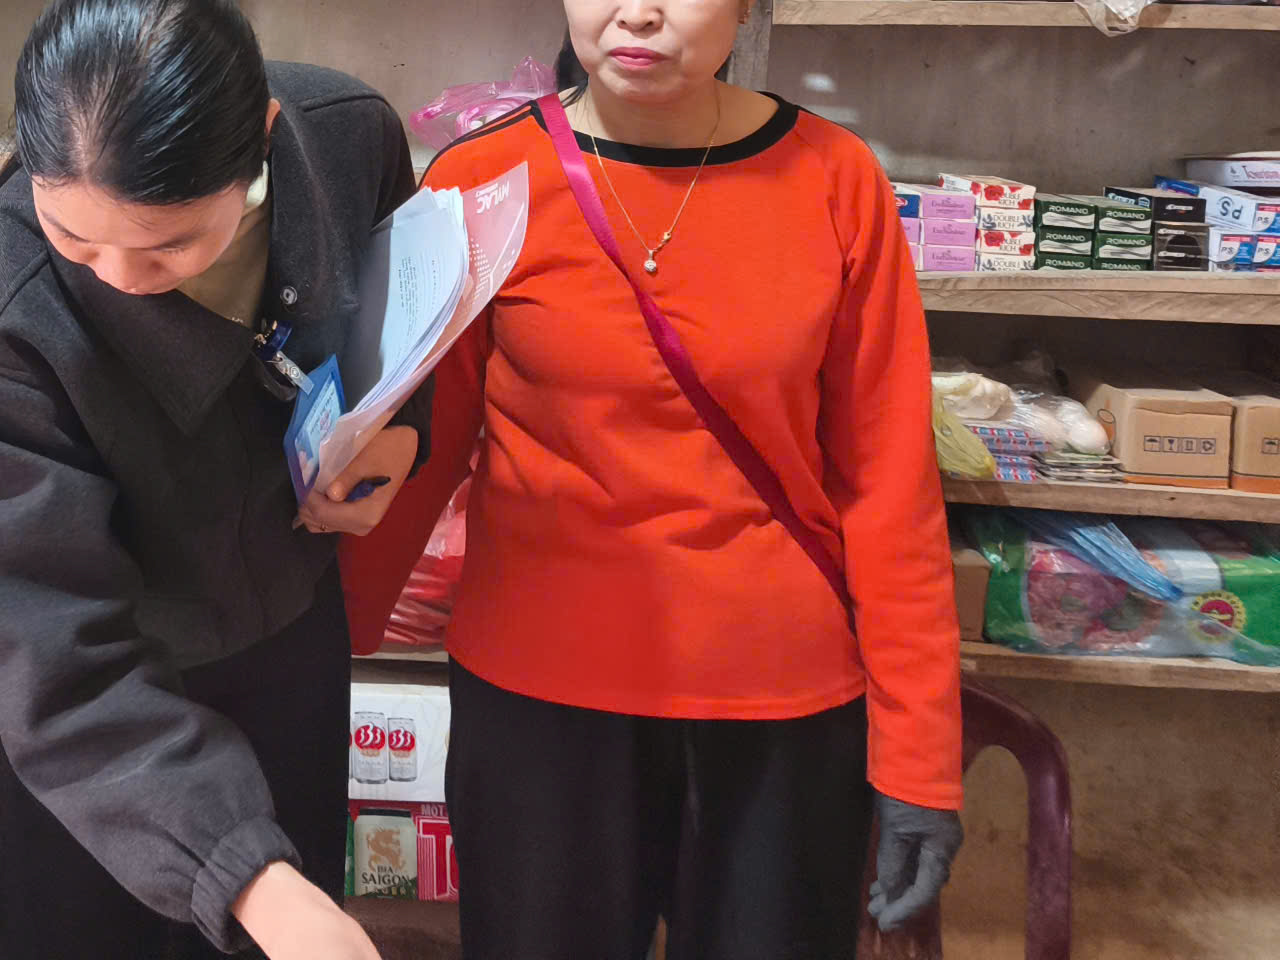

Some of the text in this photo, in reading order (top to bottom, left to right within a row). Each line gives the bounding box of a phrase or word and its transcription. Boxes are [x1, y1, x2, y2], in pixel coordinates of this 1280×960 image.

[1048, 205, 1089, 215] ROMANO
[1106, 210, 1145, 220] ROMANO
[1046, 233, 1086, 242] ROMANO
[1106, 238, 1146, 246] ROMANO
[1045, 259, 1085, 268] ROMANO
[361, 871, 410, 886] SAIGON
